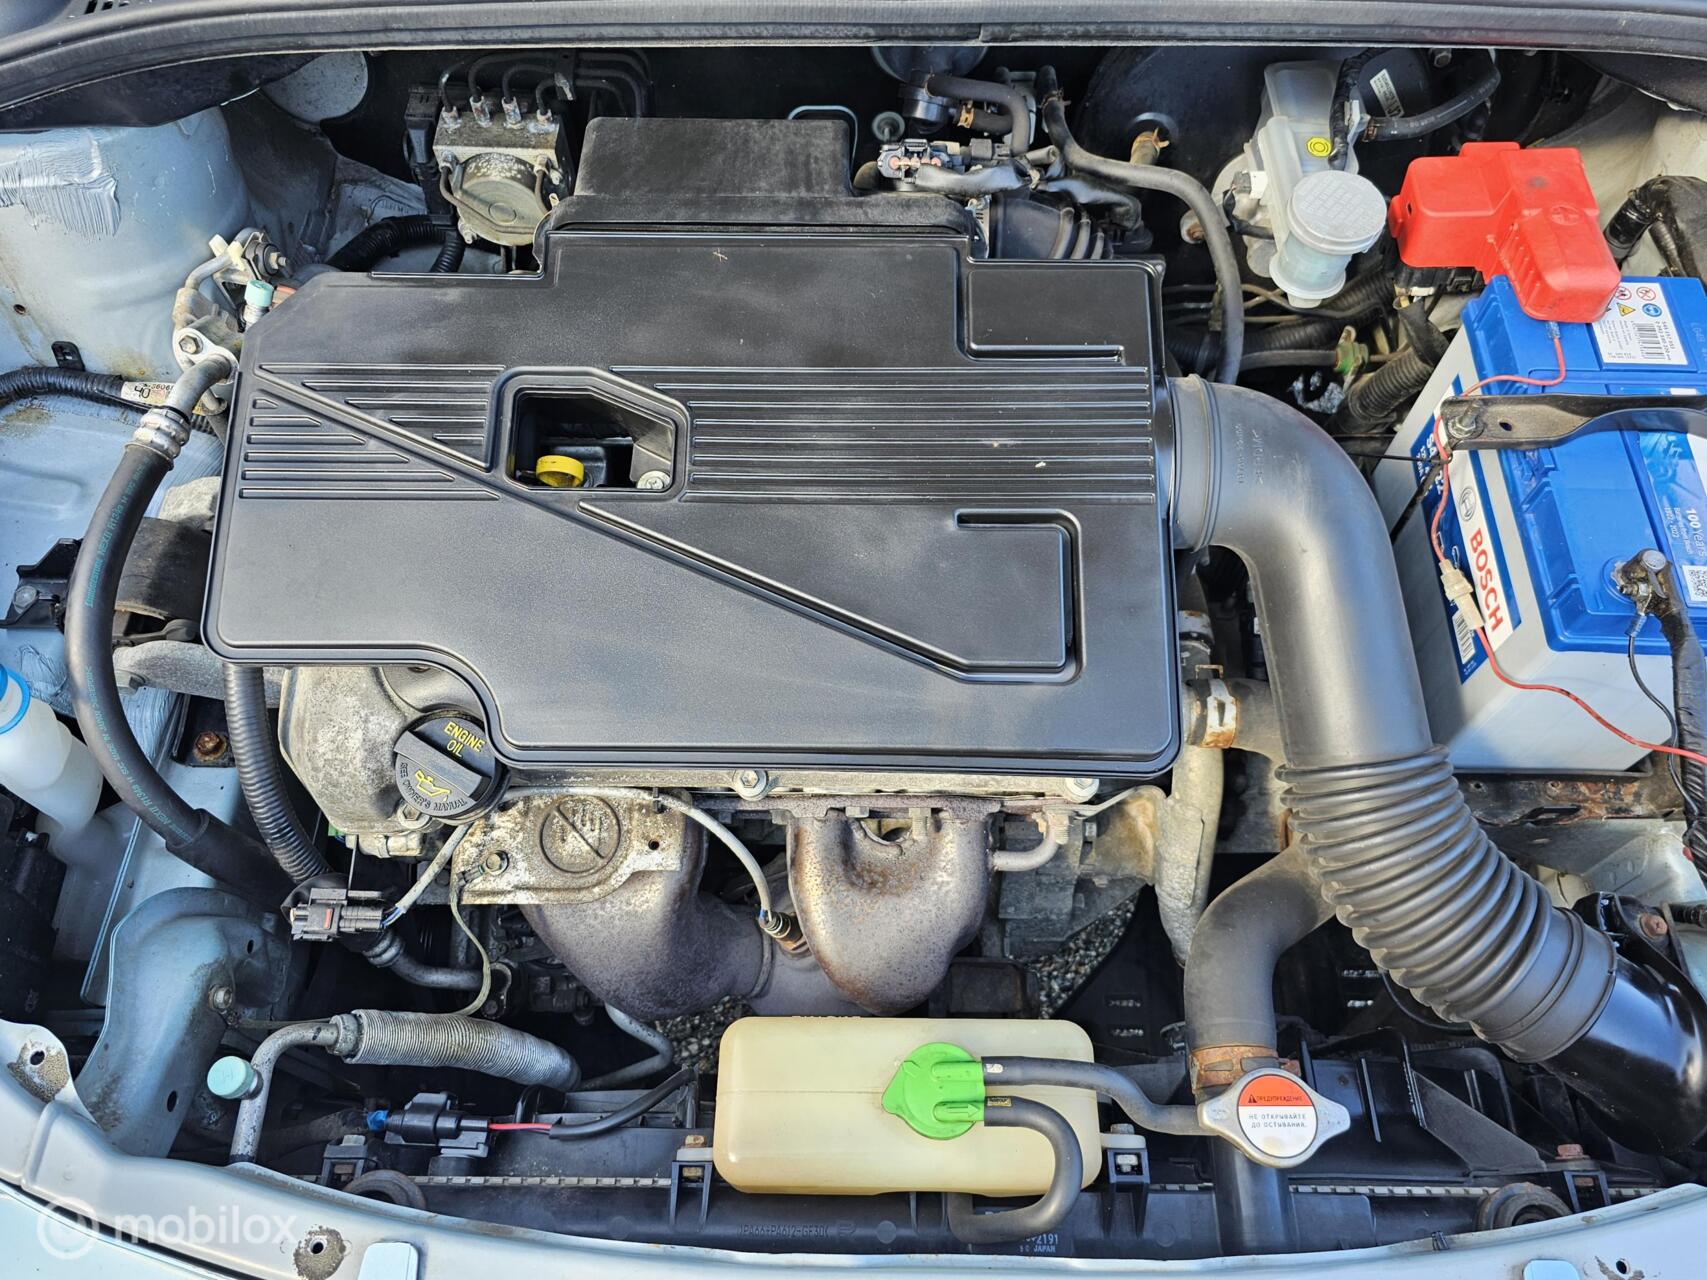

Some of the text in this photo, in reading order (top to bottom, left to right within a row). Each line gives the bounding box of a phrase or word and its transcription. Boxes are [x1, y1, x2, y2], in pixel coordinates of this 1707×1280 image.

[1686, 508, 1706, 557] 100 Years
[1470, 527, 1503, 632] BOSCH
[444, 721, 486, 752] ENGINE
[446, 740, 463, 757] OIL
[400, 762, 468, 811] SEE OWNER'S MANUAL
